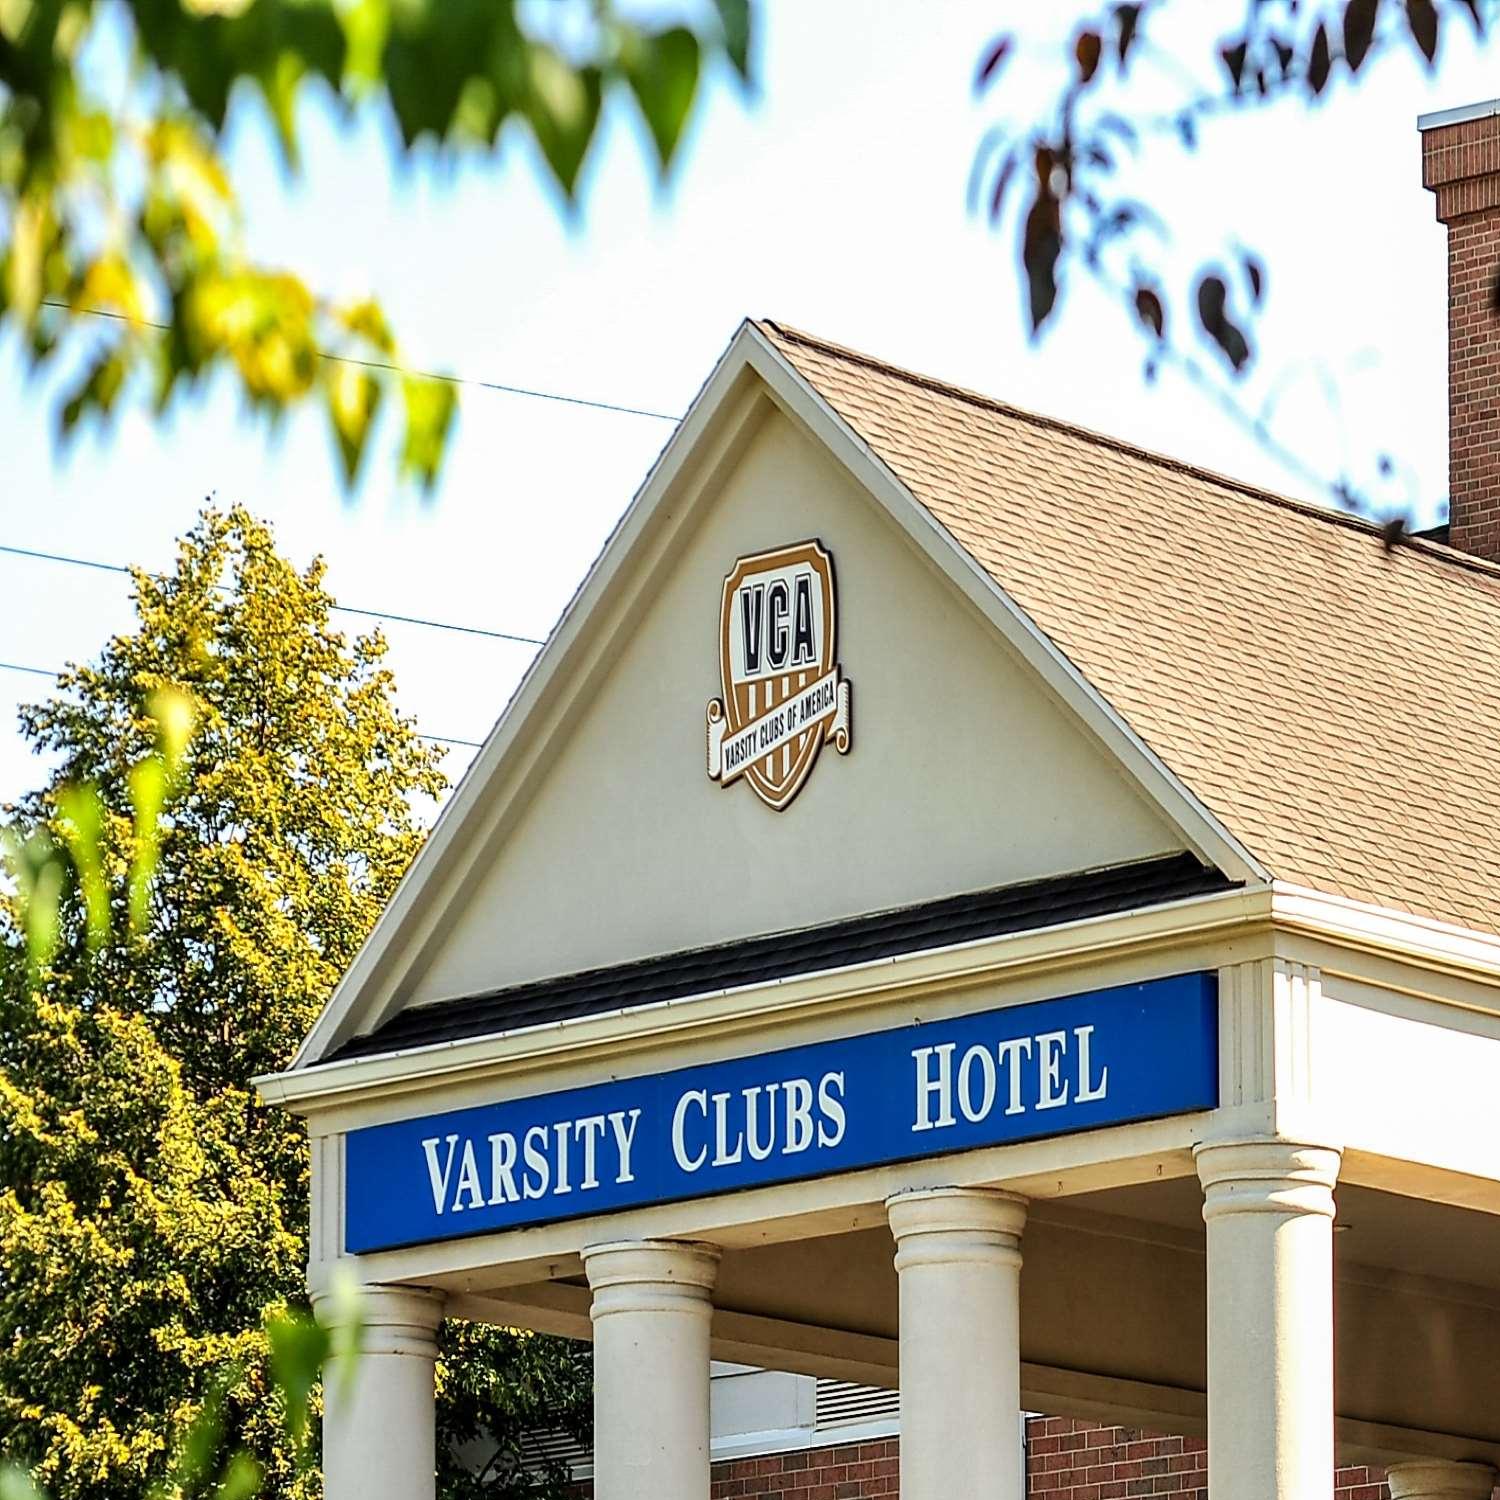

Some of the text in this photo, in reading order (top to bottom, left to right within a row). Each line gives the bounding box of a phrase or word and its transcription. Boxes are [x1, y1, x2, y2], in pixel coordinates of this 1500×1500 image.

[740, 573, 816, 676] VCA
[725, 680, 834, 771] VARSITY CLUBS OF AMERICA
[422, 1025, 1108, 1215] VARSITY CLUBS HOTEL
